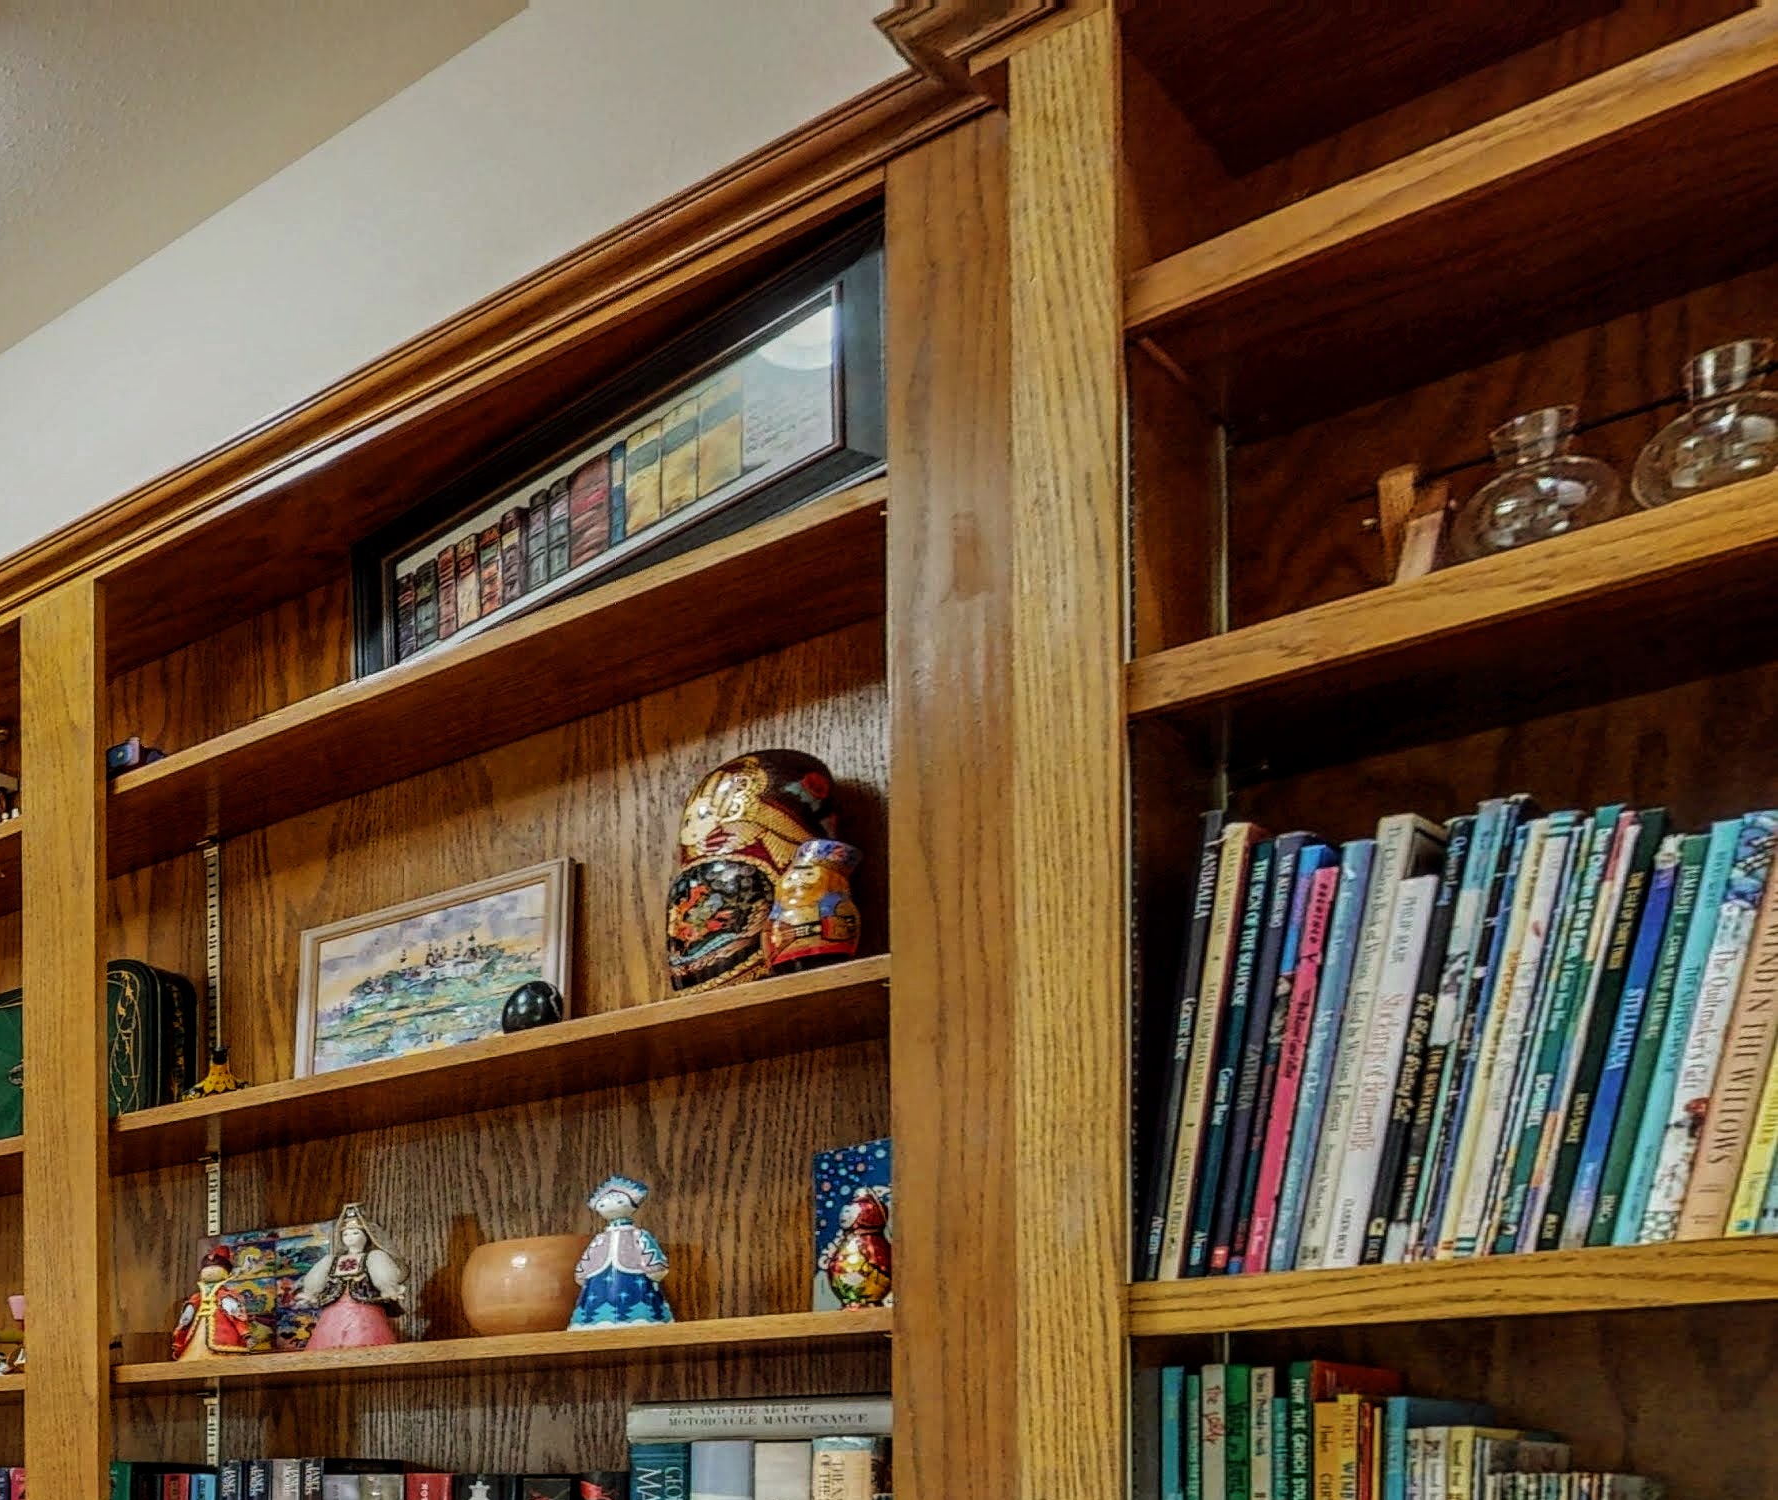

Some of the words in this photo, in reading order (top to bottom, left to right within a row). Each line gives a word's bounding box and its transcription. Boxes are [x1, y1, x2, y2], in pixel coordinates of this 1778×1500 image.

[1732, 1018, 1764, 1062] THE
[1706, 1061, 1751, 1170] WILLOWS
[1291, 1378, 1305, 1404] HOW
[668, 1414, 757, 1426] MOTORCYCLE
[764, 1413, 869, 1425] MAINTENANCE
[1291, 1409, 1306, 1428] THE
[1292, 1432, 1306, 1473] GRINCH
